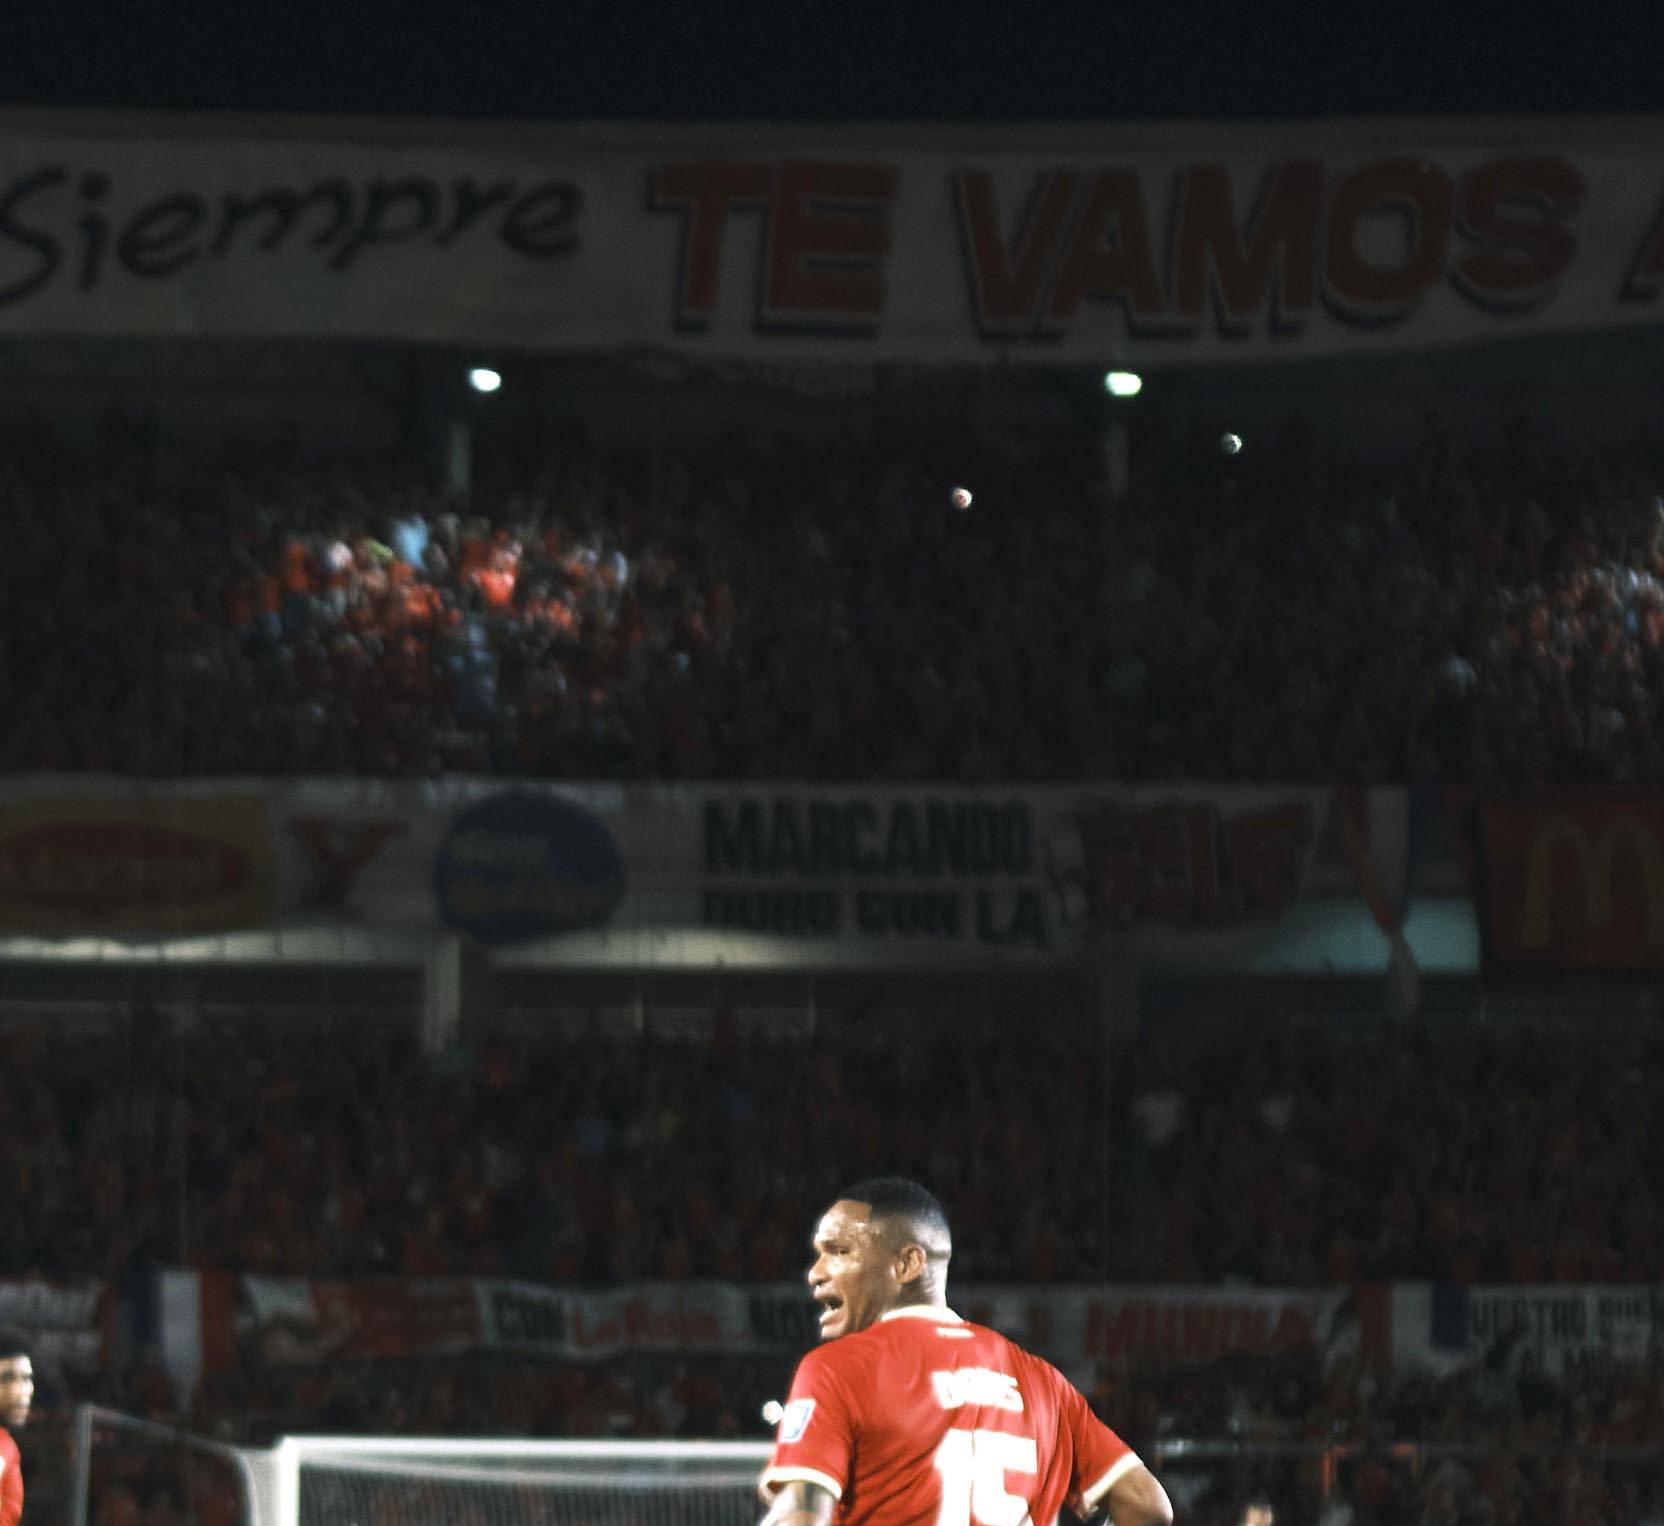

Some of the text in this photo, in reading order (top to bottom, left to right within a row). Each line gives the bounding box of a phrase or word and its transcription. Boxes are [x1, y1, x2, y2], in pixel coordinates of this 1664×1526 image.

[648, 160, 900, 334] TE
[956, 154, 1588, 341] VAMOS
[702, 799, 1034, 877] MARCANDO
